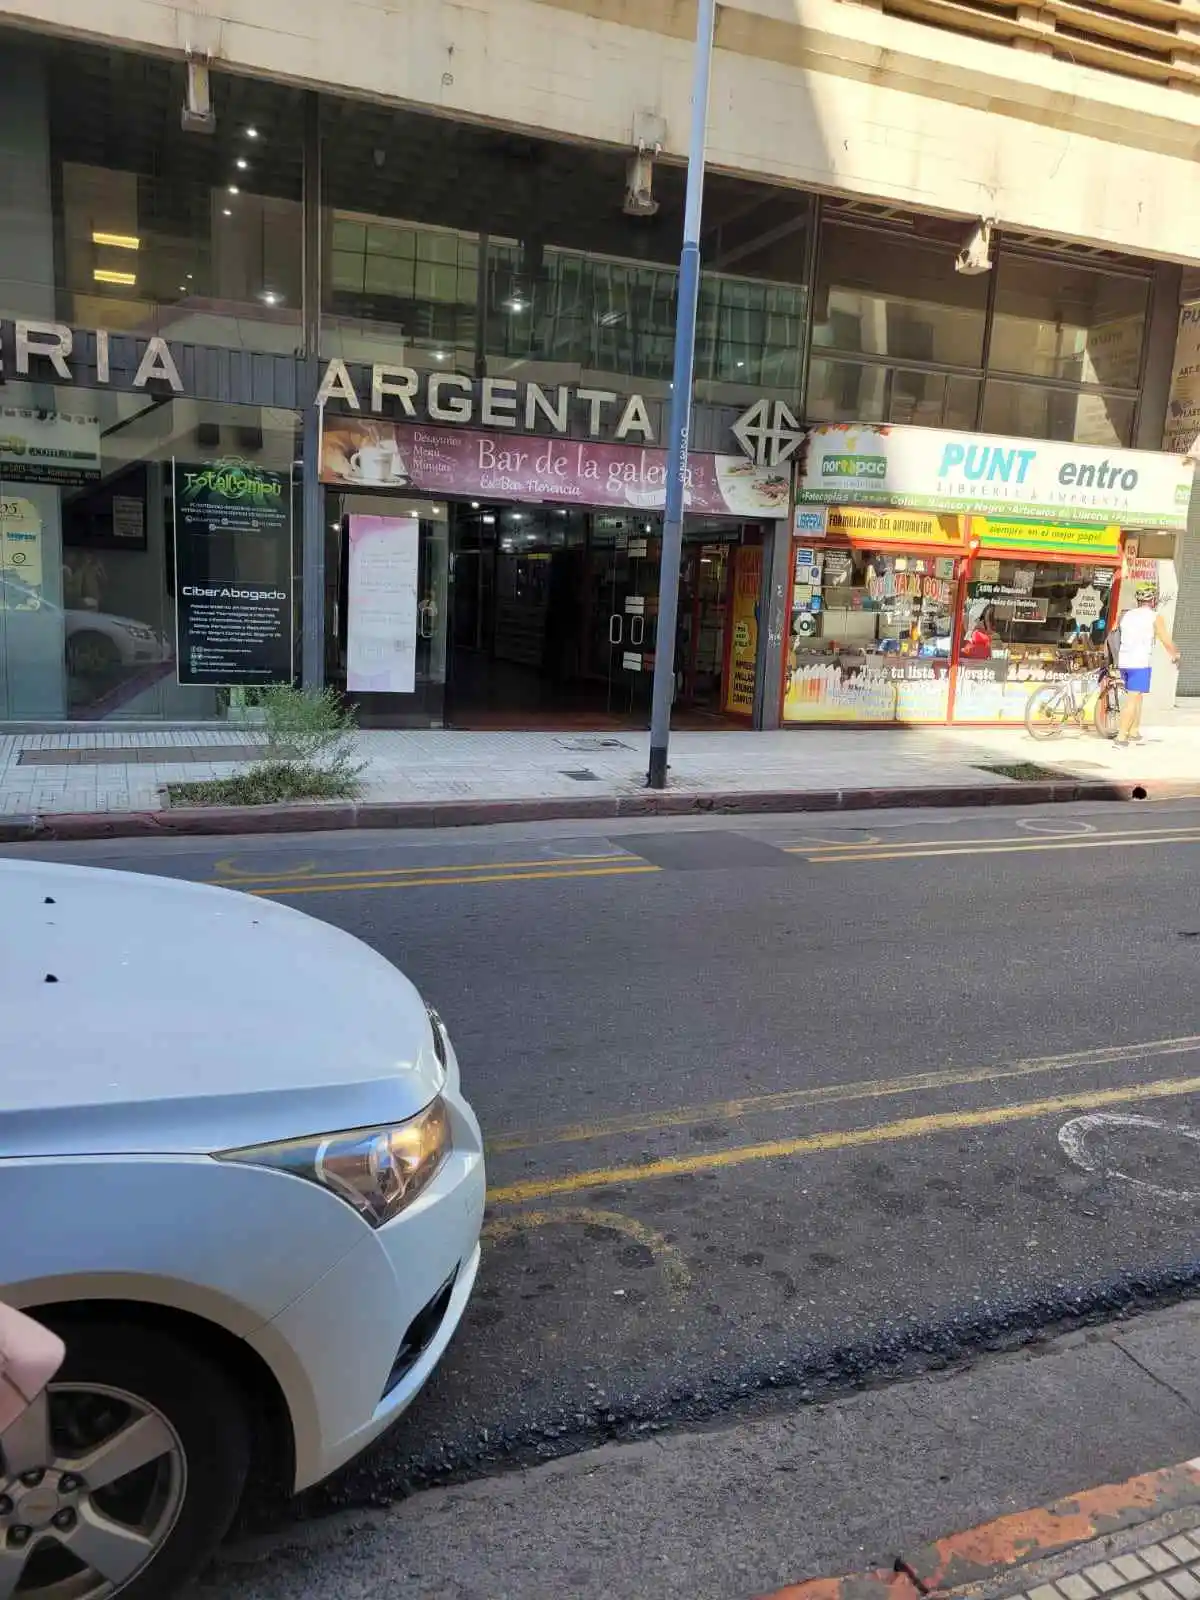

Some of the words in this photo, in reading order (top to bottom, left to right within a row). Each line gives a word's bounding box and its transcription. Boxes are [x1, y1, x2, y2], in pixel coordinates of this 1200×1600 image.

[0, 319, 184, 392] RIA
[316, 357, 655, 441] ARGENTA
[477, 438, 527, 471] Bar
[535, 440, 568, 476] de
[577, 444, 601, 481] la
[605, 448, 693, 492] galera
[938, 443, 1036, 484] PUNT
[1058, 459, 1139, 491] entro
[906, 665, 935, 679] lista
